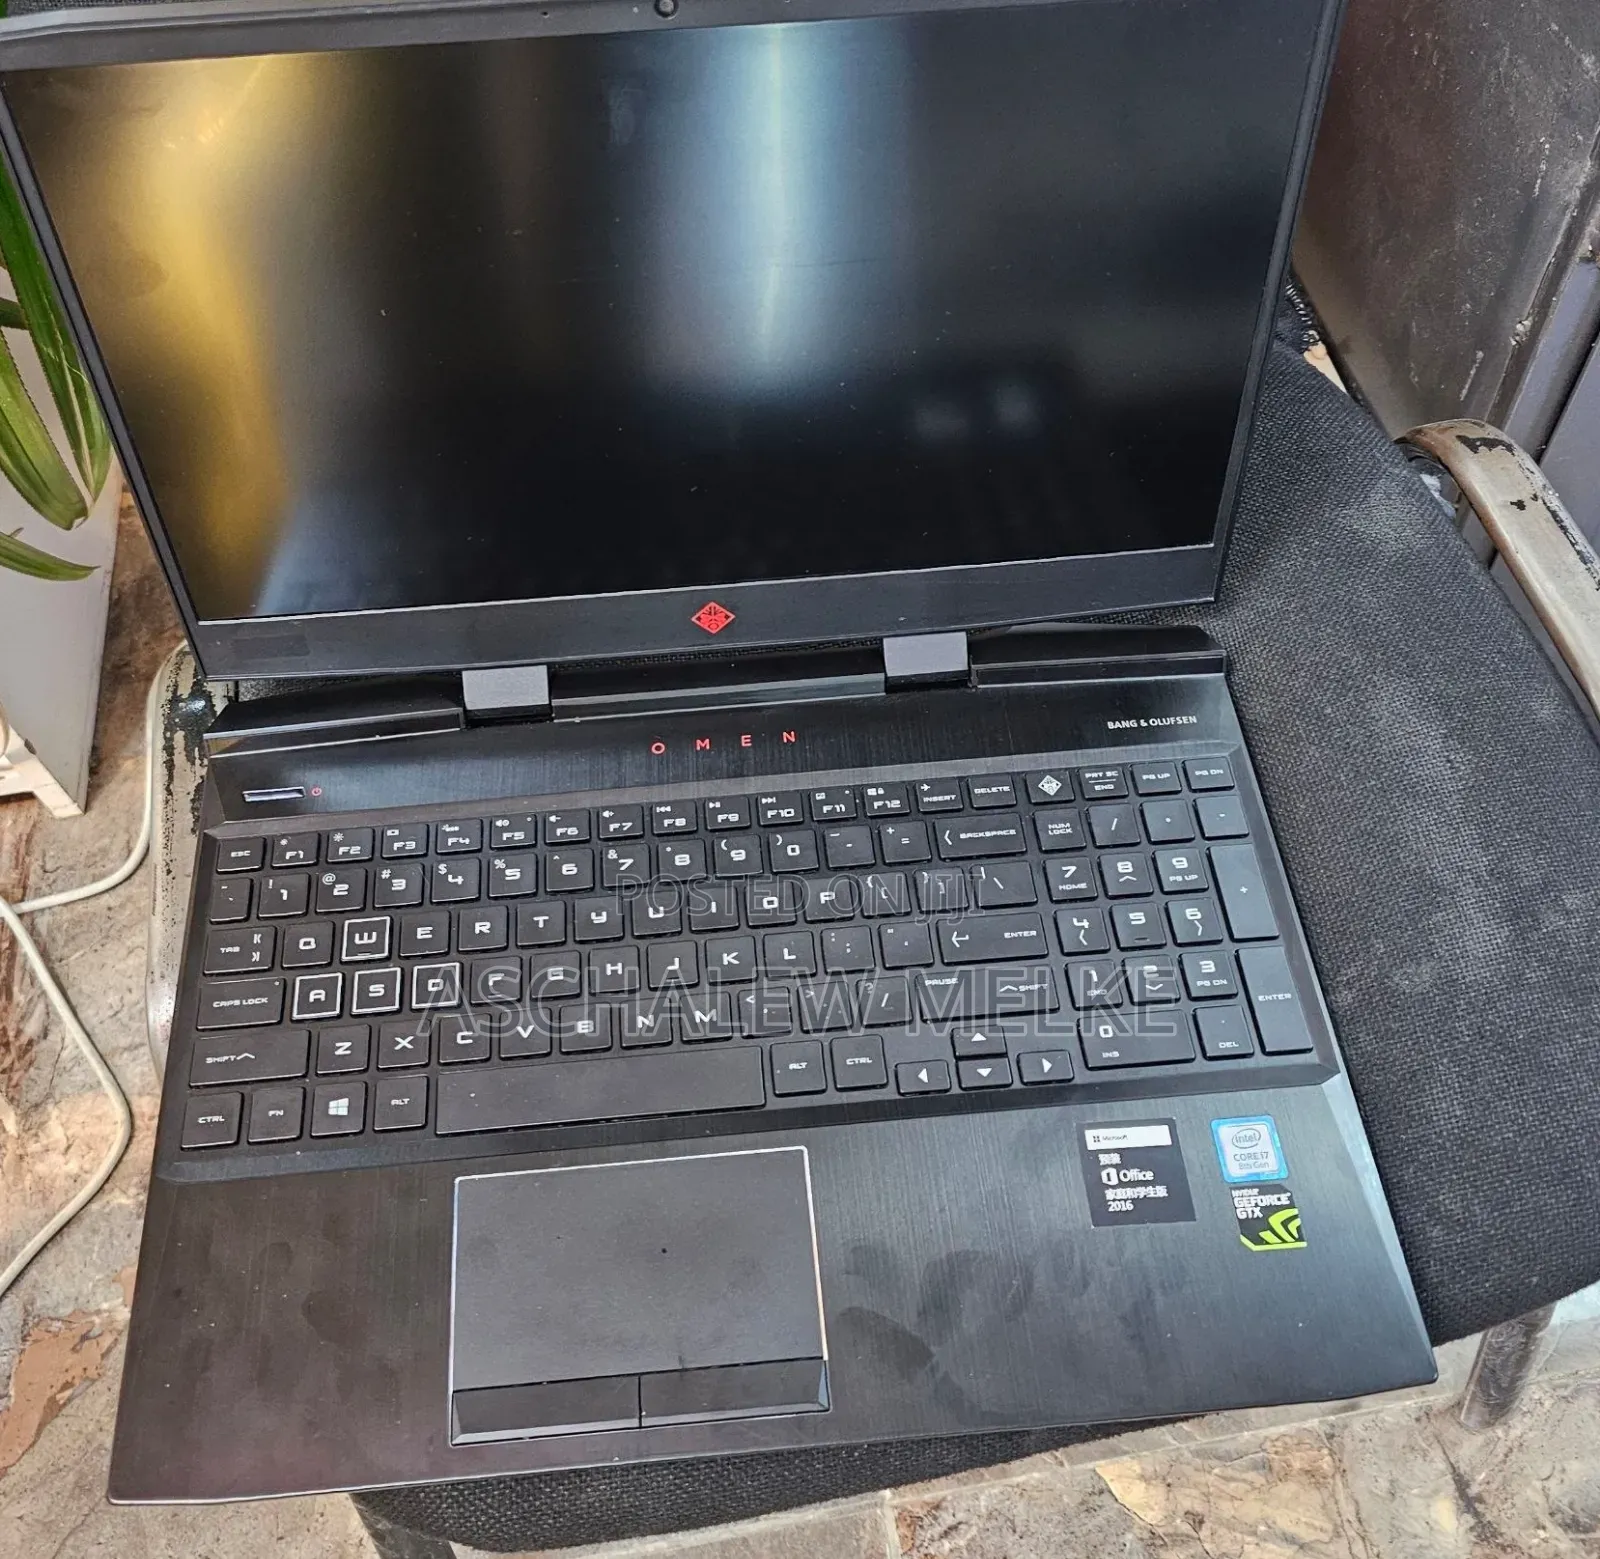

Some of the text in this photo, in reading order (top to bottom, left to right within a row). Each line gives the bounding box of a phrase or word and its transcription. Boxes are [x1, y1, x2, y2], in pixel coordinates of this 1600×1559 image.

[1107, 715, 1197, 730] BANG & OLUFSEN
[651, 730, 796, 755] OMEN
[974, 786, 1010, 794] DELETE
[923, 794, 957, 803] INSERT
[822, 804, 846, 814] F11
[873, 800, 901, 810] F12
[717, 813, 739, 823] F9
[767, 808, 795, 819] F10
[609, 822, 633, 833] F7
[663, 818, 687, 828] F8
[1111, 818, 1118, 831] /
[502, 831, 525, 841] F5
[556, 827, 579, 837] F6
[886, 826, 895, 835] +
[960, 829, 1016, 839] BACKSPACE
[1048, 828, 1073, 836] LOCK
[393, 841, 416, 851] F3
[447, 837, 470, 847] F4
[720, 839, 727, 850] (
[776, 834, 783, 846] )
[285, 850, 304, 860] F1
[338, 845, 361, 856] F2
[607, 850, 618, 860] &
[730, 849, 746, 861] 9
[494, 859, 506, 869] %
[618, 858, 634, 871] 7
[674, 854, 691, 866] 8
[1172, 857, 1189, 869] 9
[438, 863, 448, 875] $
[561, 863, 578, 875] 6
[1062, 866, 1077, 878] 7
[1116, 861, 1134, 873] 8
[322, 873, 336, 885] @
[381, 869, 391, 879] #
[448, 874, 465, 885] 4
[505, 868, 521, 881] 5
[268, 879, 273, 889] !
[391, 878, 406, 891] 3
[993, 877, 1004, 890] \
[1058, 882, 1087, 891] HOME
[280, 888, 288, 901] 1
[333, 884, 349, 896] 2
[1240, 886, 1248, 894] +
[762, 896, 779, 909] O
[819, 891, 835, 904] P
[590, 911, 607, 923] Y
[648, 906, 664, 918] U
[1185, 908, 1202, 920] 6
[533, 916, 549, 928] T
[1072, 917, 1089, 929] 4
[1129, 912, 1146, 925] 5
[416, 926, 433, 939] E
[475, 922, 491, 935] R
[1004, 930, 1037, 939] ENTER
[299, 938, 317, 950] Q
[354, 931, 377, 945] W
[220, 946, 240, 954] TAB
[783, 948, 796, 960] L
[667, 957, 679, 970] J
[722, 952, 740, 965] K
[606, 963, 622, 975] H
[1143, 965, 1159, 979] 2
[1199, 960, 1216, 973] 3
[547, 968, 564, 981] G
[1089, 970, 1098, 982] 1
[925, 977, 958, 986] PAUSE
[1018, 983, 1048, 992] SHIFT
[309, 989, 326, 1002] A
[368, 984, 385, 997] S
[212, 997, 268, 1008] CAPS LOCK
[746, 995, 755, 1004] <
[881, 993, 889, 1007] /
[1258, 993, 1292, 1002] ENTER
[637, 1014, 654, 1028] N
[694, 1009, 717, 1023] M
[516, 1025, 534, 1038] V
[577, 1020, 594, 1033] B
[394, 1036, 414, 1050] X
[456, 1031, 473, 1044] C
[334, 1042, 352, 1056] Z
[1218, 1041, 1239, 1049] DEL
[205, 1055, 236, 1064] SHIFT
[846, 1057, 873, 1065] CTRL
[789, 1062, 808, 1070] ALT
[198, 1115, 225, 1123] CTRL
[1235, 1132, 1258, 1144] intel
[1233, 1152, 1269, 1162] CORE i7
[1254, 1161, 1270, 1169] Gen
[1119, 1168, 1154, 1182] Office
[1107, 1200, 1135, 1212] 2016
[1233, 1192, 1292, 1208] GEFORCE
[1236, 1207, 1263, 1219] GTX
